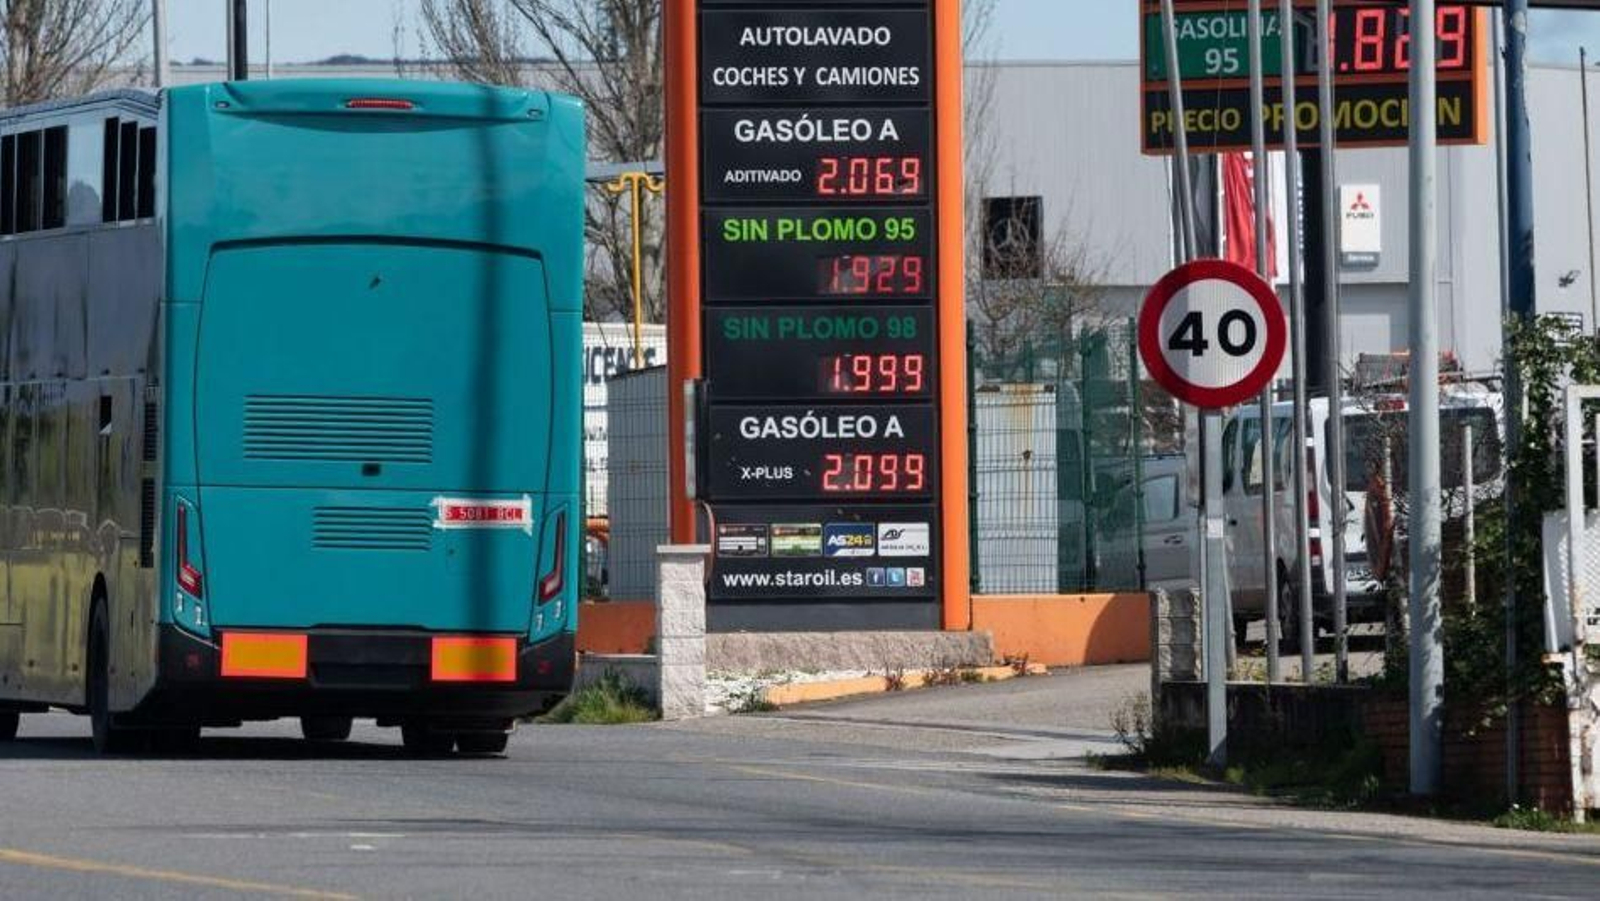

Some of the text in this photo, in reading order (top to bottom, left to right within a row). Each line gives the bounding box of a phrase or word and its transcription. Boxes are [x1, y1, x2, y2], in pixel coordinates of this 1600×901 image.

[739, 26, 891, 46] AUTOLAVADO
[1173, 15, 1283, 40] ASOLIA
[1204, 47, 1240, 75] 95
[713, 66, 920, 86] COCHES Y CAMIONES
[734, 113, 899, 142] GASÓLEO A
[724, 157, 921, 194] ADITIVADO 2.069
[723, 217, 915, 241] SIN PLOMO 95
[832, 256, 921, 292] 1.929
[723, 316, 917, 340] SIN PLOMO 98
[1168, 308, 1257, 358] 40
[834, 355, 922, 391] 1.999
[739, 410, 904, 438] GASÓLEO A
[741, 454, 923, 490] X-PLUS 2.099
[723, 569, 863, 587] www.staroil.es
